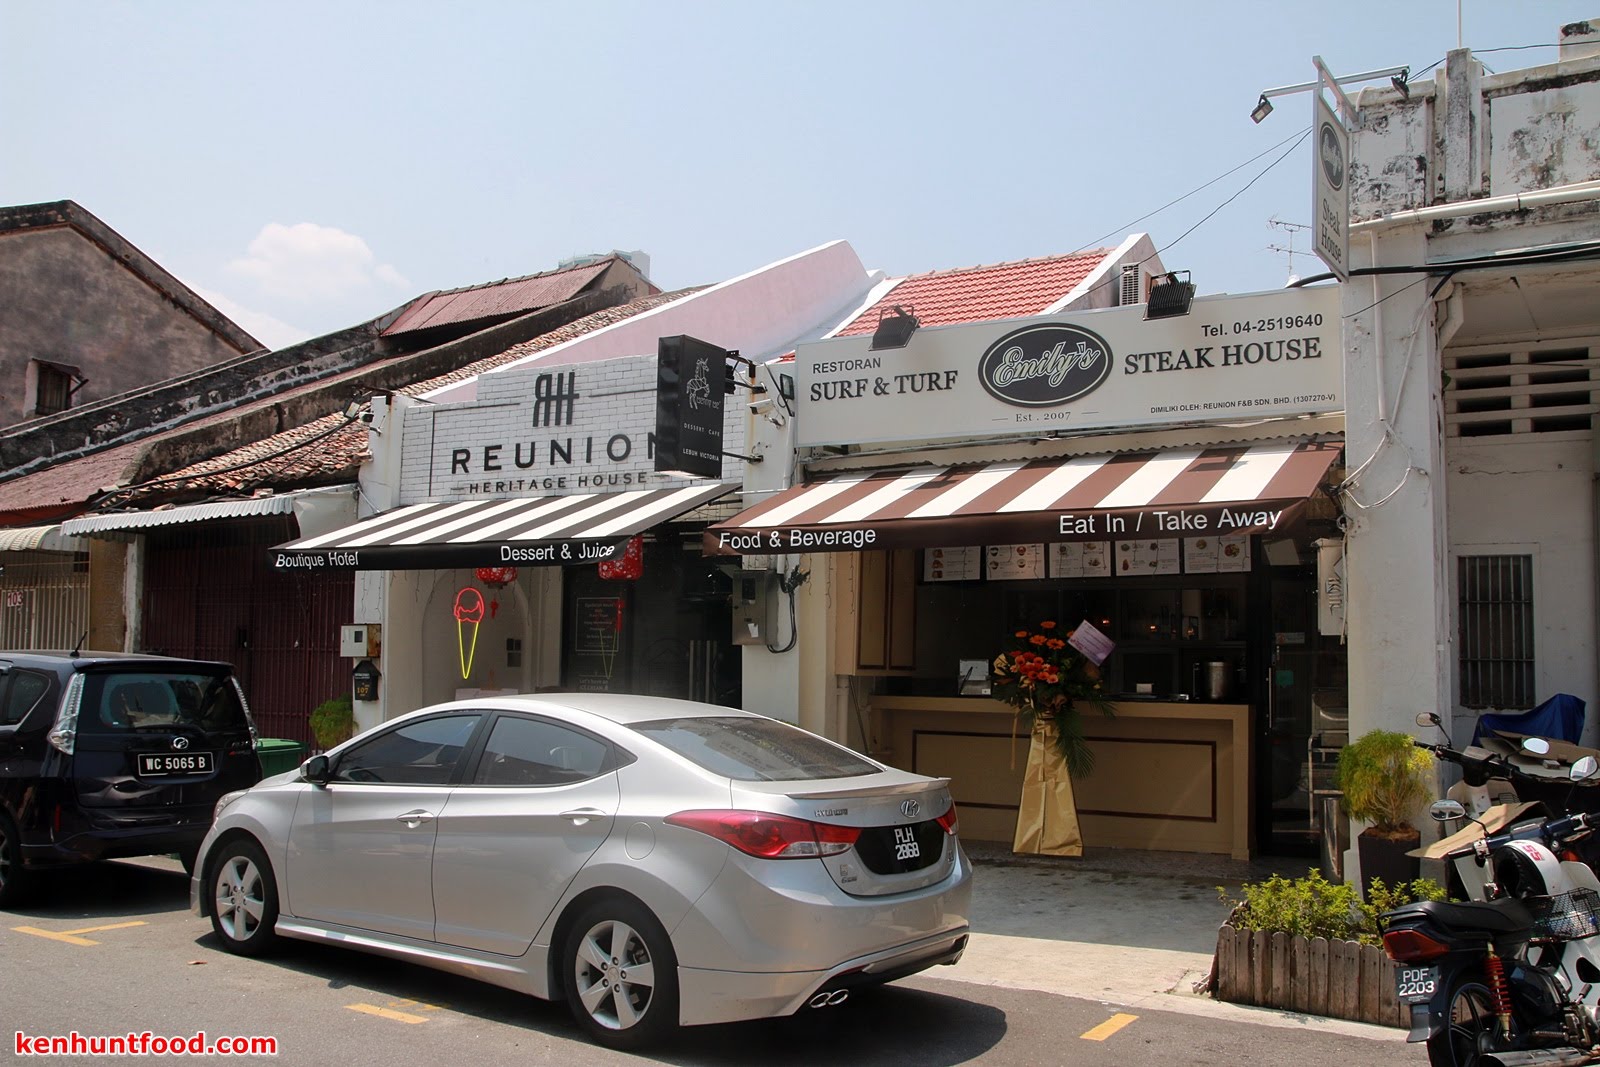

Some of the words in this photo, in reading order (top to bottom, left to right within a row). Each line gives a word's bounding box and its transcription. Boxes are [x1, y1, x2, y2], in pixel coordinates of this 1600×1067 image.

[1322, 198, 1341, 237] Steak
[1321, 223, 1342, 264] House
[1201, 324, 1228, 337] Tel.
[1233, 313, 1323, 335] 04-2519640
[993, 341, 1101, 387] Emily's
[1124, 347, 1216, 375] STEAK
[1221, 336, 1322, 366] HOUSE
[812, 358, 881, 374] RESTORAN
[810, 378, 868, 402] SURF
[873, 376, 890, 396] &
[894, 370, 959, 394] TURF
[1150, 405, 1179, 414] DIMILIKI
[1179, 403, 1202, 412] OLEH:
[1203, 401, 1236, 410] REUNION
[1237, 399, 1253, 407] F&B
[1254, 398, 1272, 406] SDN.
[1273, 396, 1292, 405] BHD.
[1293, 393, 1336, 404] (1307270-V)
[1043, 412, 1072, 421] 2007
[682, 447, 698, 456] LEBUH
[700, 452, 720, 461] VICTORIA
[469, 477, 566, 494] HERITAGE
[578, 471, 647, 488] HOUSE
[1058, 514, 1095, 534] Eat
[1106, 512, 1125, 533] In
[1153, 510, 1208, 531] Take
[1217, 508, 1283, 530] Away
[718, 531, 761, 550] Food
[768, 530, 782, 548] &
[789, 528, 877, 548] Beverage
[275, 553, 325, 570] Boutique
[328, 551, 359, 566] Hotel
[501, 545, 555, 562] Dessert
[561, 545, 572, 560] &
[578, 543, 616, 559] Juice
[7, 592, 24, 607] 103
[146, 758, 162, 770] WC
[165, 757, 195, 770] 5065
[198, 756, 206, 769] B
[894, 827, 914, 844] PLH
[895, 842, 920, 860] 2868
[1403, 968, 1429, 982] PDF
[1399, 981, 1434, 996] 2203
